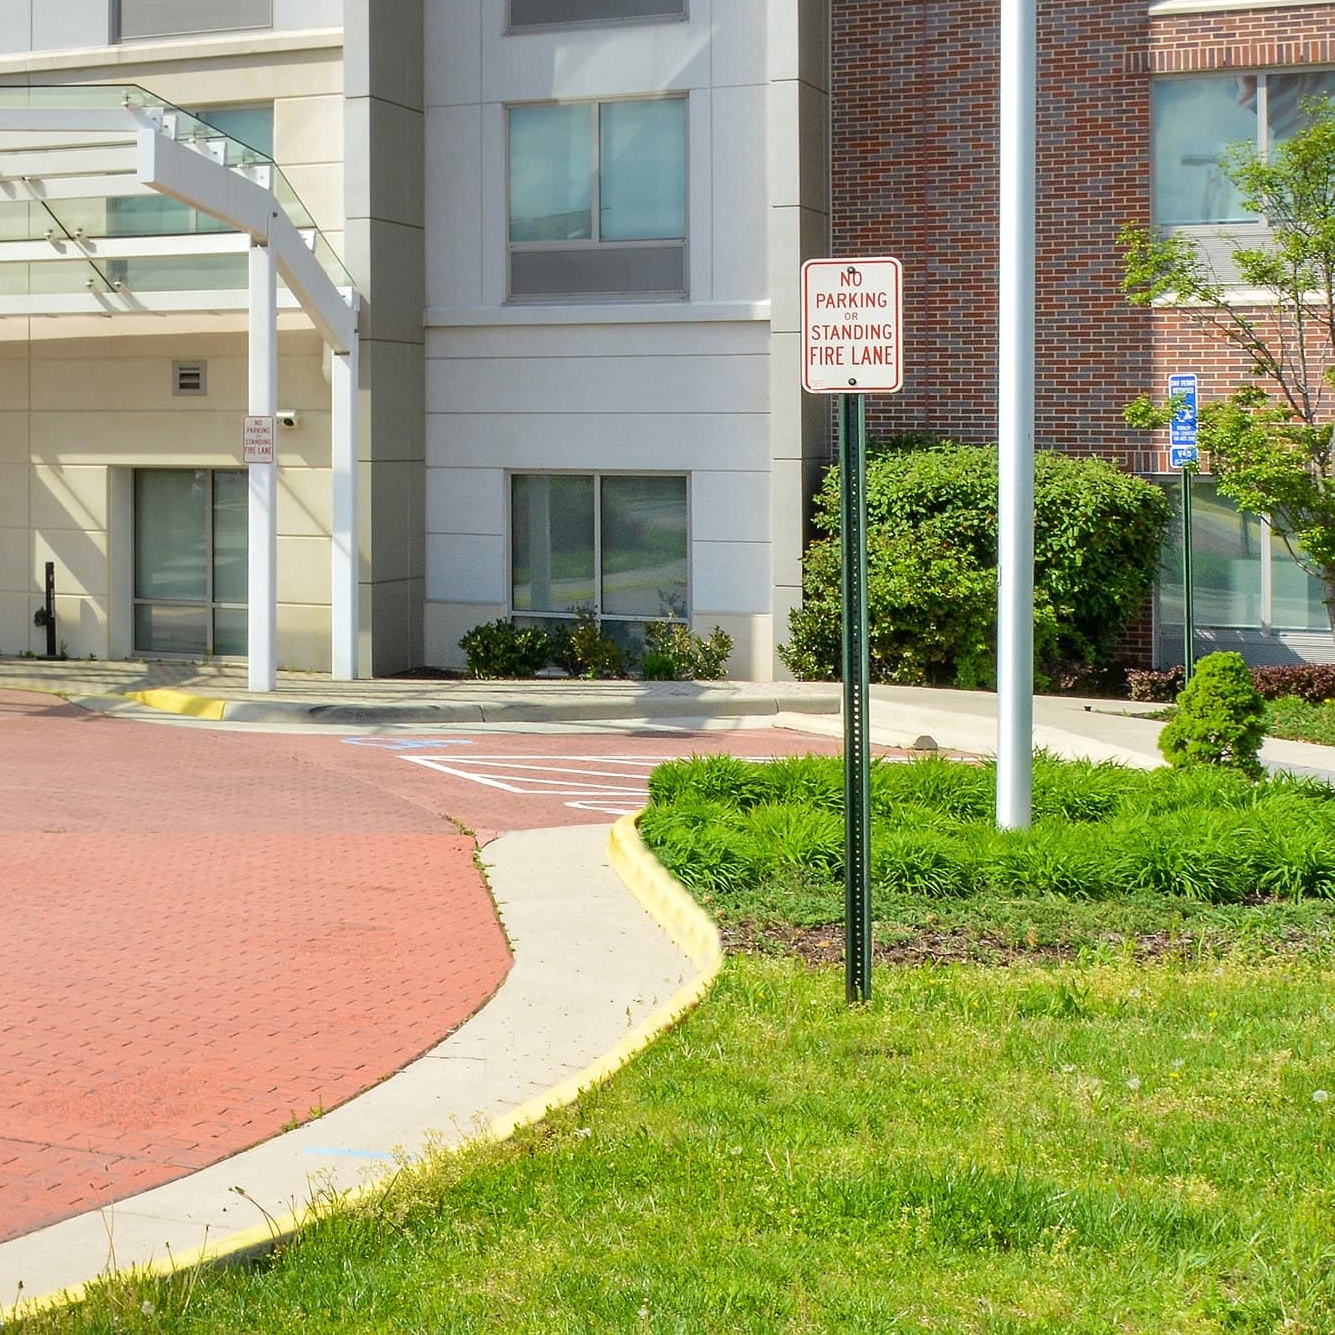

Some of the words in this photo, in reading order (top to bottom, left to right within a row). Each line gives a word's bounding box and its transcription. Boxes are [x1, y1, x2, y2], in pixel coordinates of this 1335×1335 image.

[840, 270, 863, 287] NO
[816, 291, 888, 309] PARKING
[844, 312, 858, 321] OR
[811, 323, 893, 341] STANDING
[810, 346, 845, 366] FIRE
[851, 345, 894, 365] LANE
[245, 446, 256, 454] FIRE
[258, 446, 271, 455] LANE
